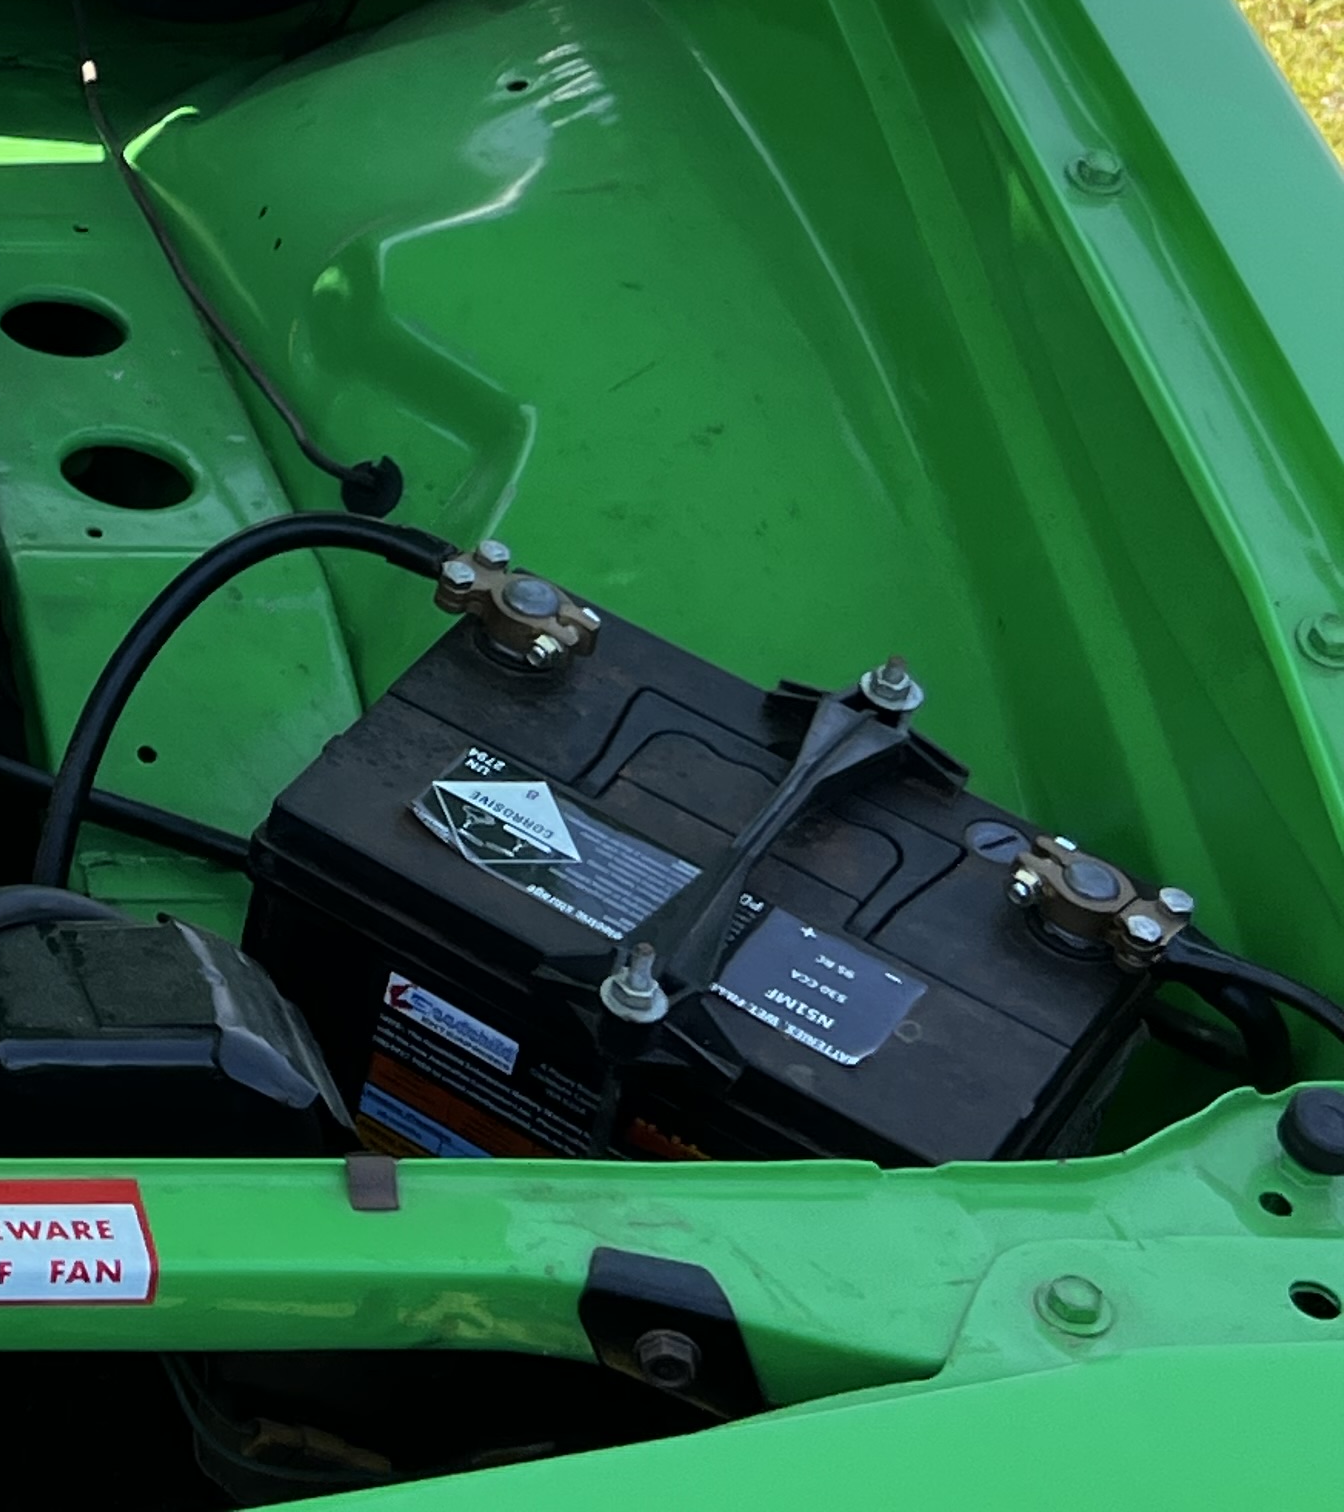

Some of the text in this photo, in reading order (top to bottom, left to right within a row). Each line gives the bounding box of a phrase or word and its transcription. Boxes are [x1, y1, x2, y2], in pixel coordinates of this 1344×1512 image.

[465, 758, 491, 776] UN
[468, 791, 554, 839] CORROSIVE
[790, 969, 819, 988] CCA
[49, 1259, 123, 1285] FAN
